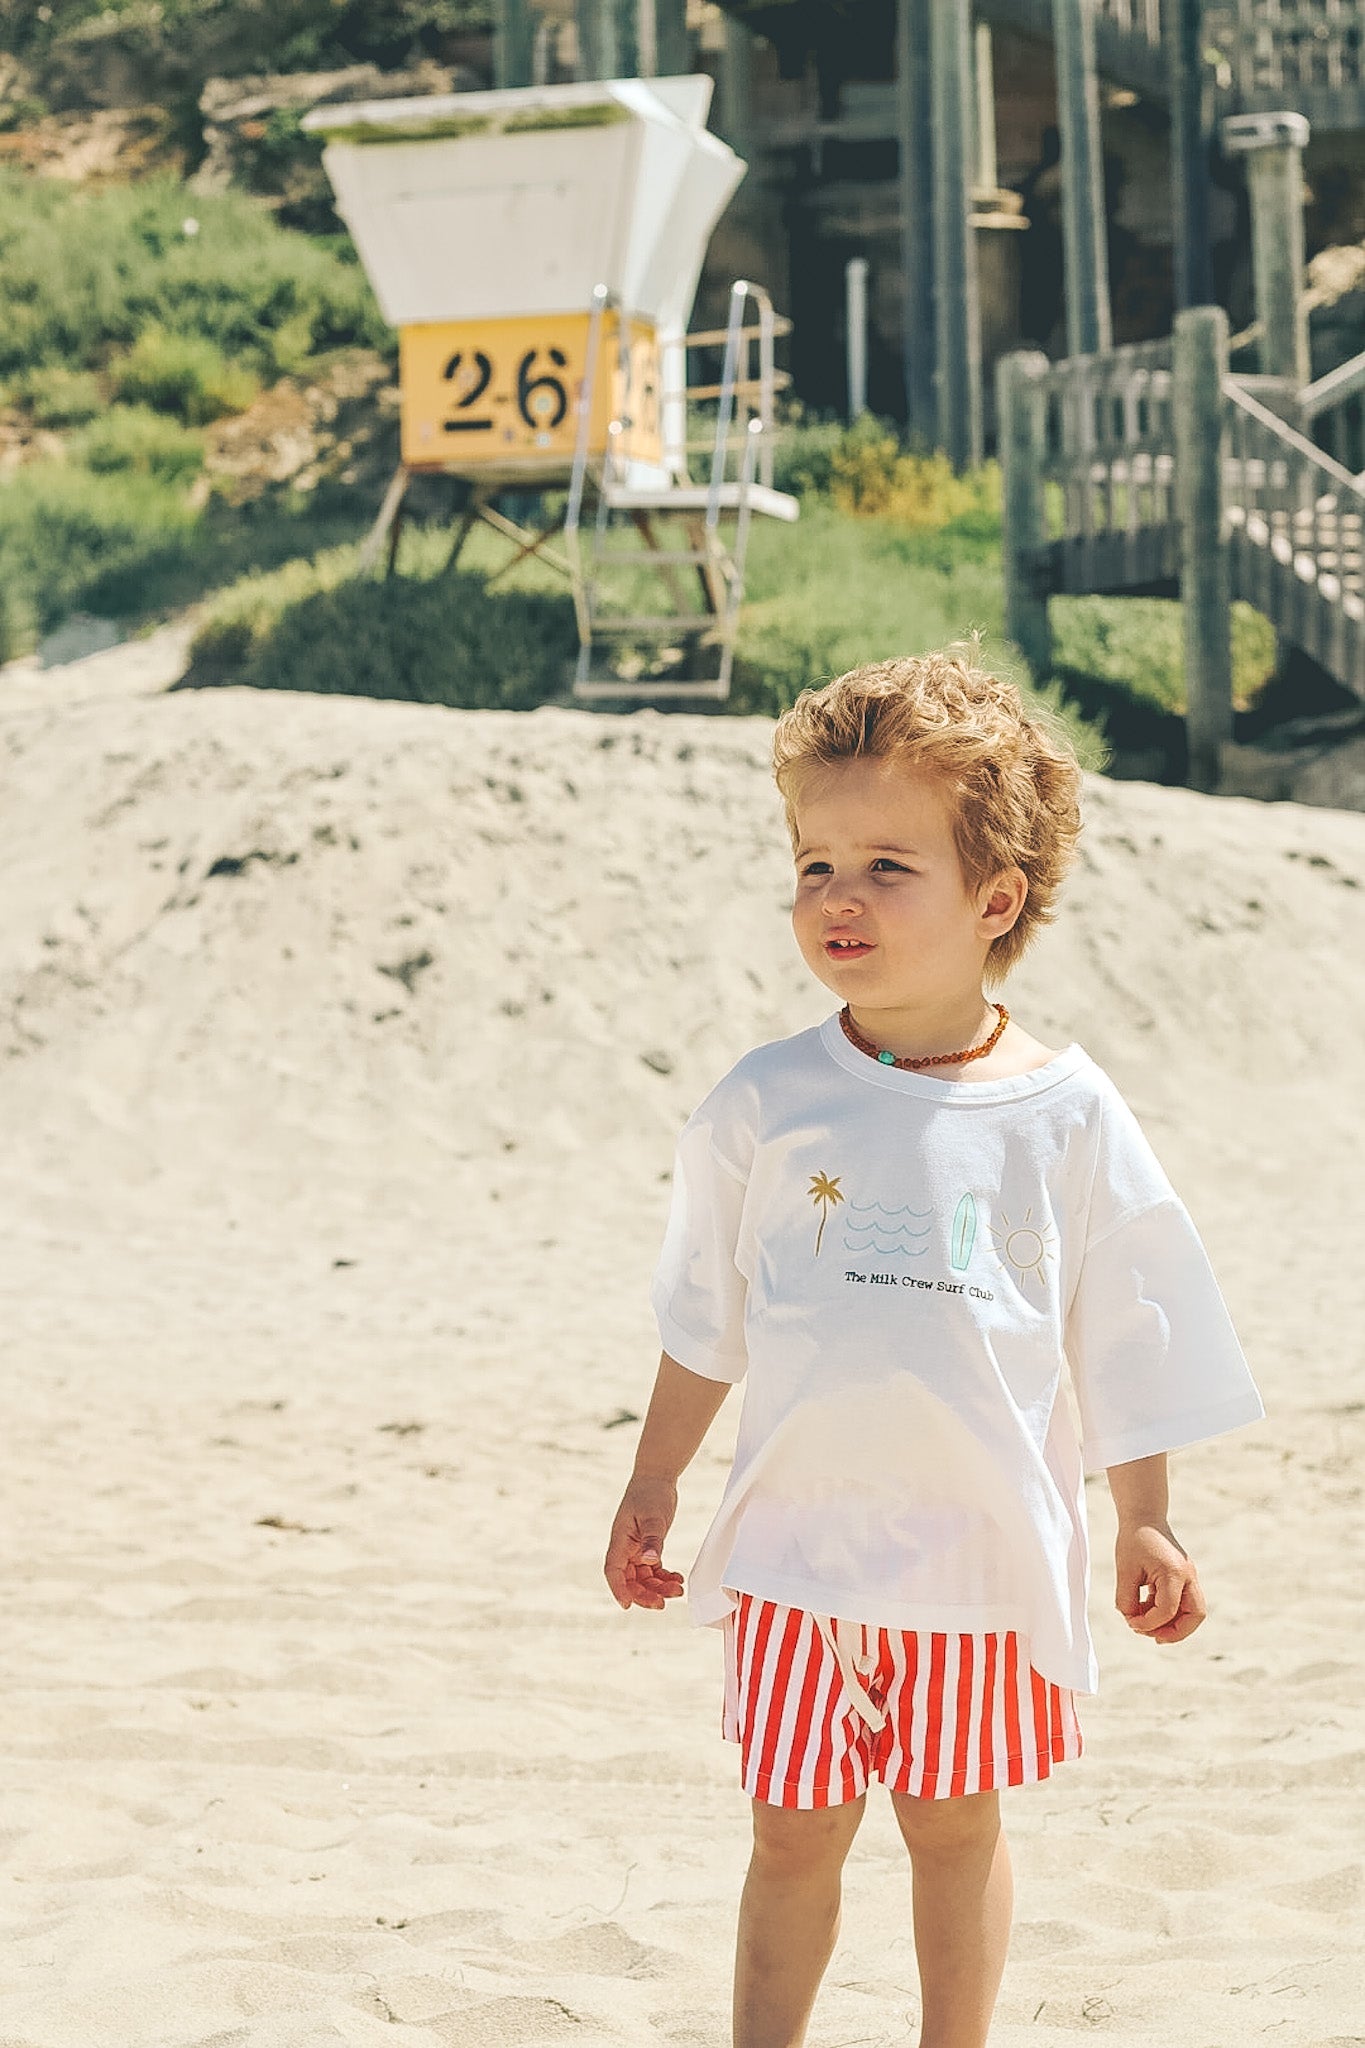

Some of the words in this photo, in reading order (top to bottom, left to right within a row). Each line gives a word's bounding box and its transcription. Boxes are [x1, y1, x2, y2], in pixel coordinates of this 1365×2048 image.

[444, 348, 567, 432] 26
[844, 1271, 867, 1283] The
[870, 1273, 898, 1285] Milk
[901, 1276, 934, 1290] Crew
[936, 1281, 966, 1294] Surf
[968, 1286, 994, 1301] Club
